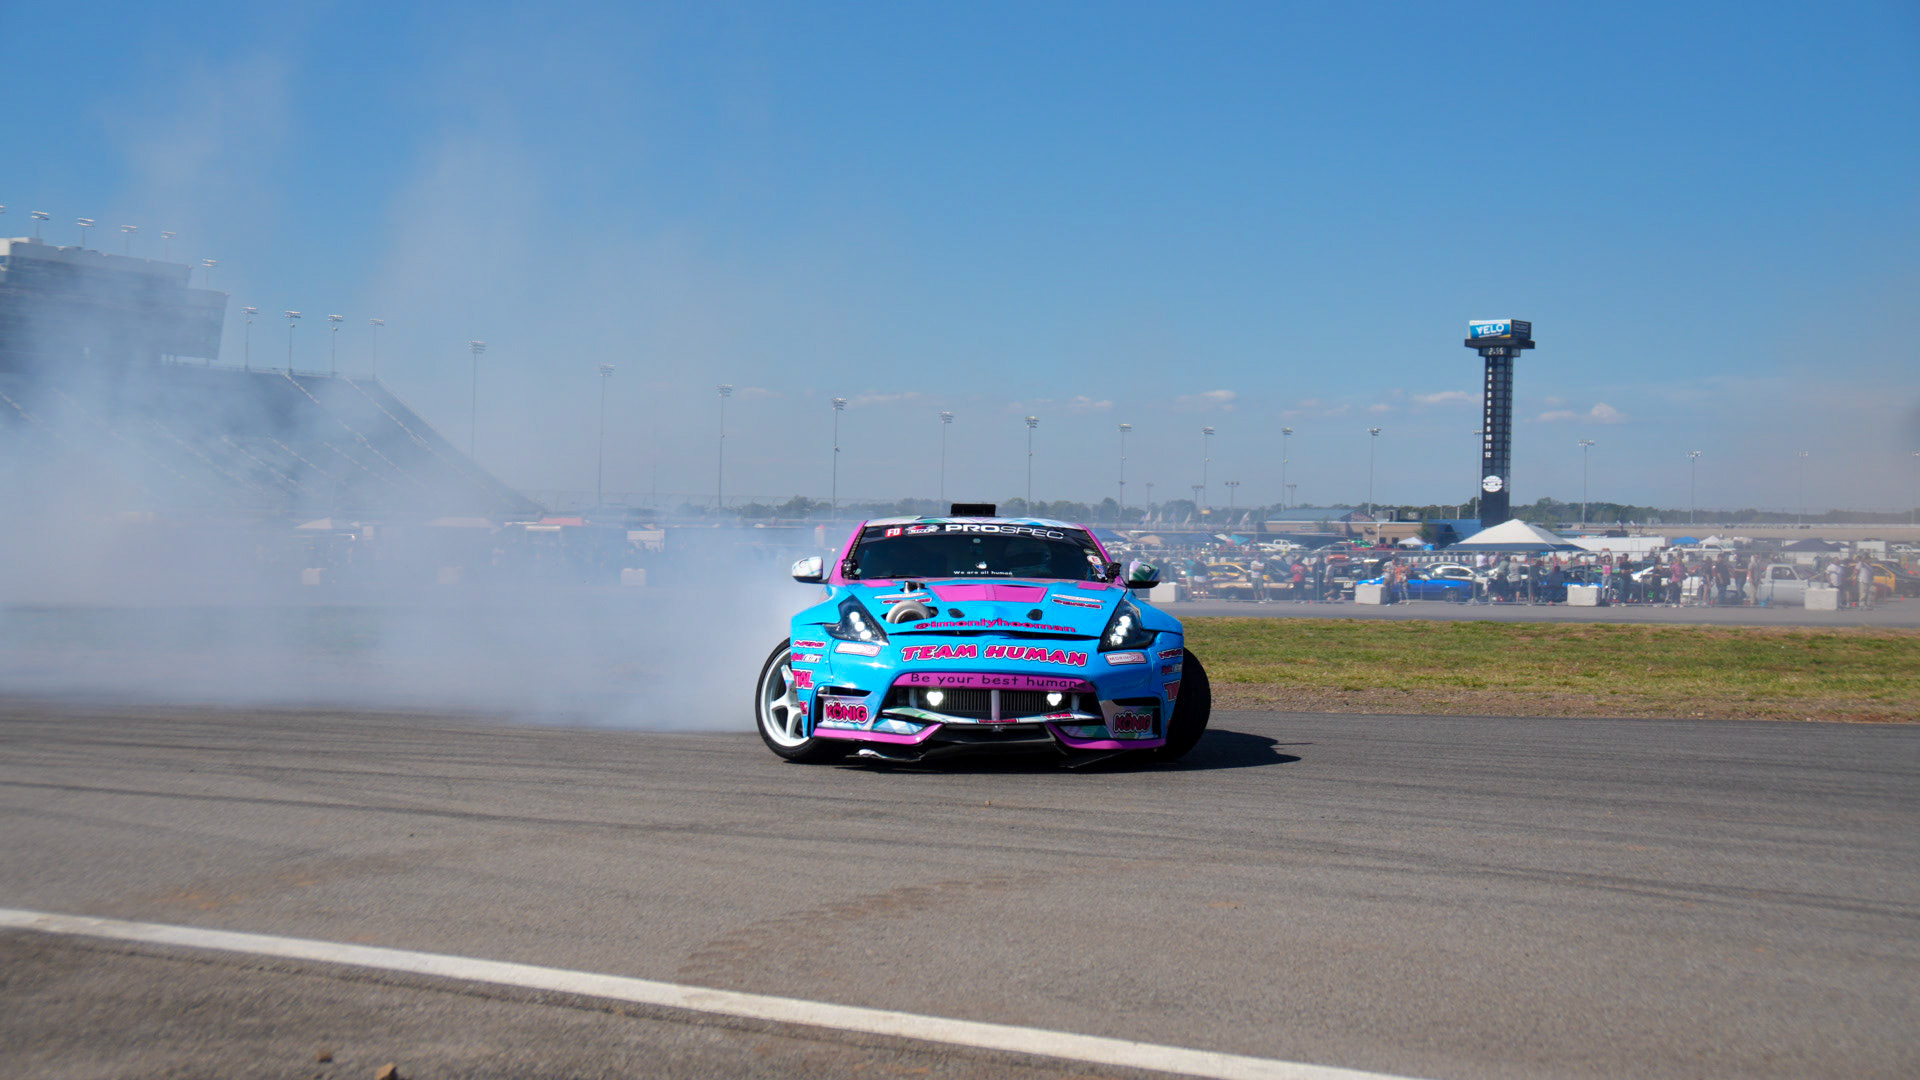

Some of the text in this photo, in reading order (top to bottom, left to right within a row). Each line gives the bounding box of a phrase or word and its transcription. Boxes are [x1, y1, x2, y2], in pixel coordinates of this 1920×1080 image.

[1476, 323, 1504, 335] VELO
[887, 528, 901, 537] FD
[945, 524, 1064, 540] PROSPEC
[914, 618, 1076, 633] @imonlyhooman
[902, 644, 978, 662] TEAM
[984, 645, 1088, 667] HUMAN
[911, 673, 1079, 687] Be your best human
